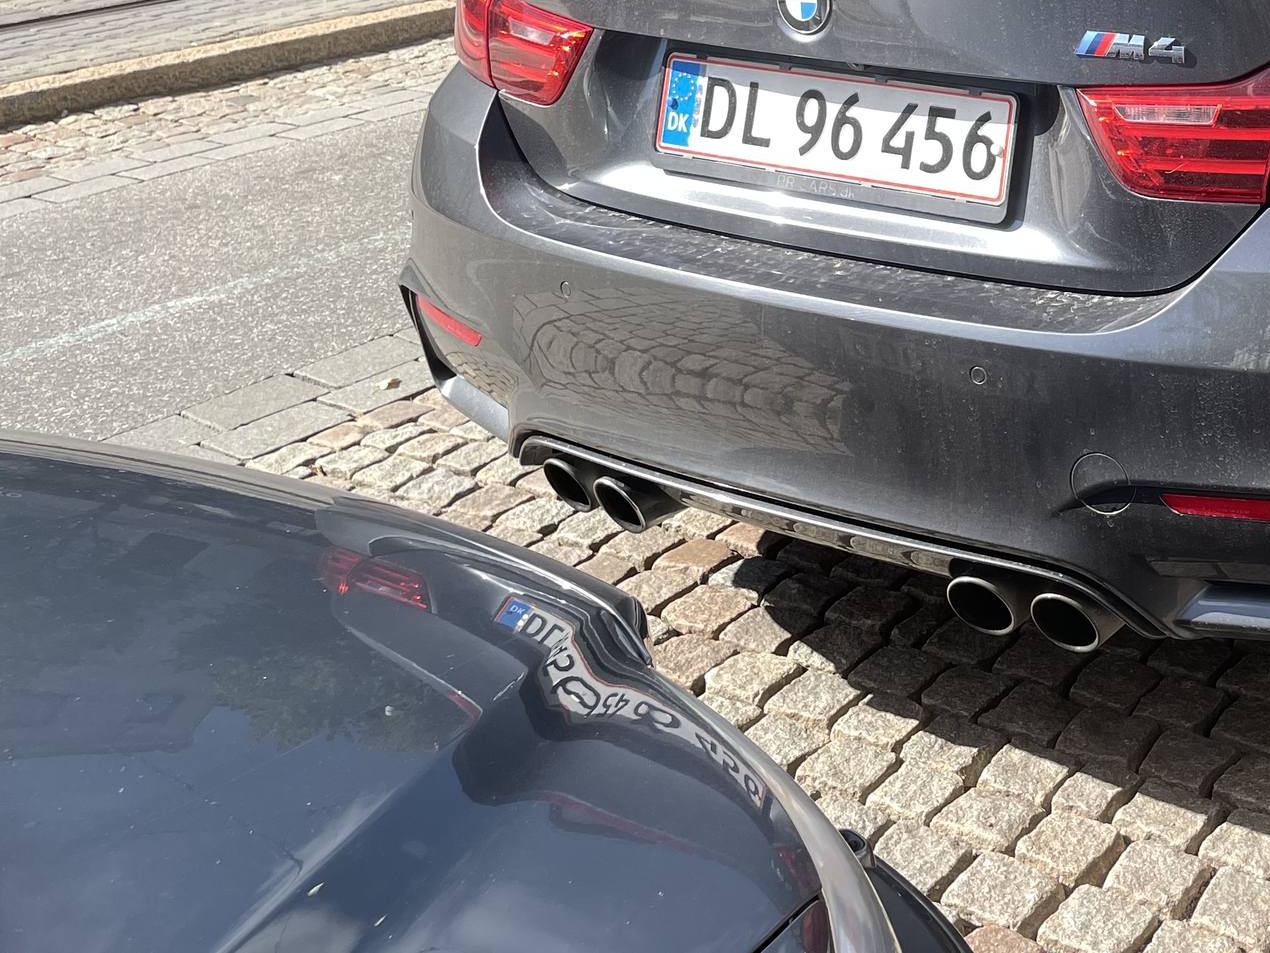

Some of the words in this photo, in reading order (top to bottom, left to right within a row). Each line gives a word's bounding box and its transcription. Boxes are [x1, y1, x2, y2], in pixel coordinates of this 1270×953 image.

[1104, 32, 1186, 64] M4
[666, 112, 689, 133] DK
[700, 76, 771, 148] DL
[796, 88, 863, 161] 96
[881, 102, 998, 181] 456
